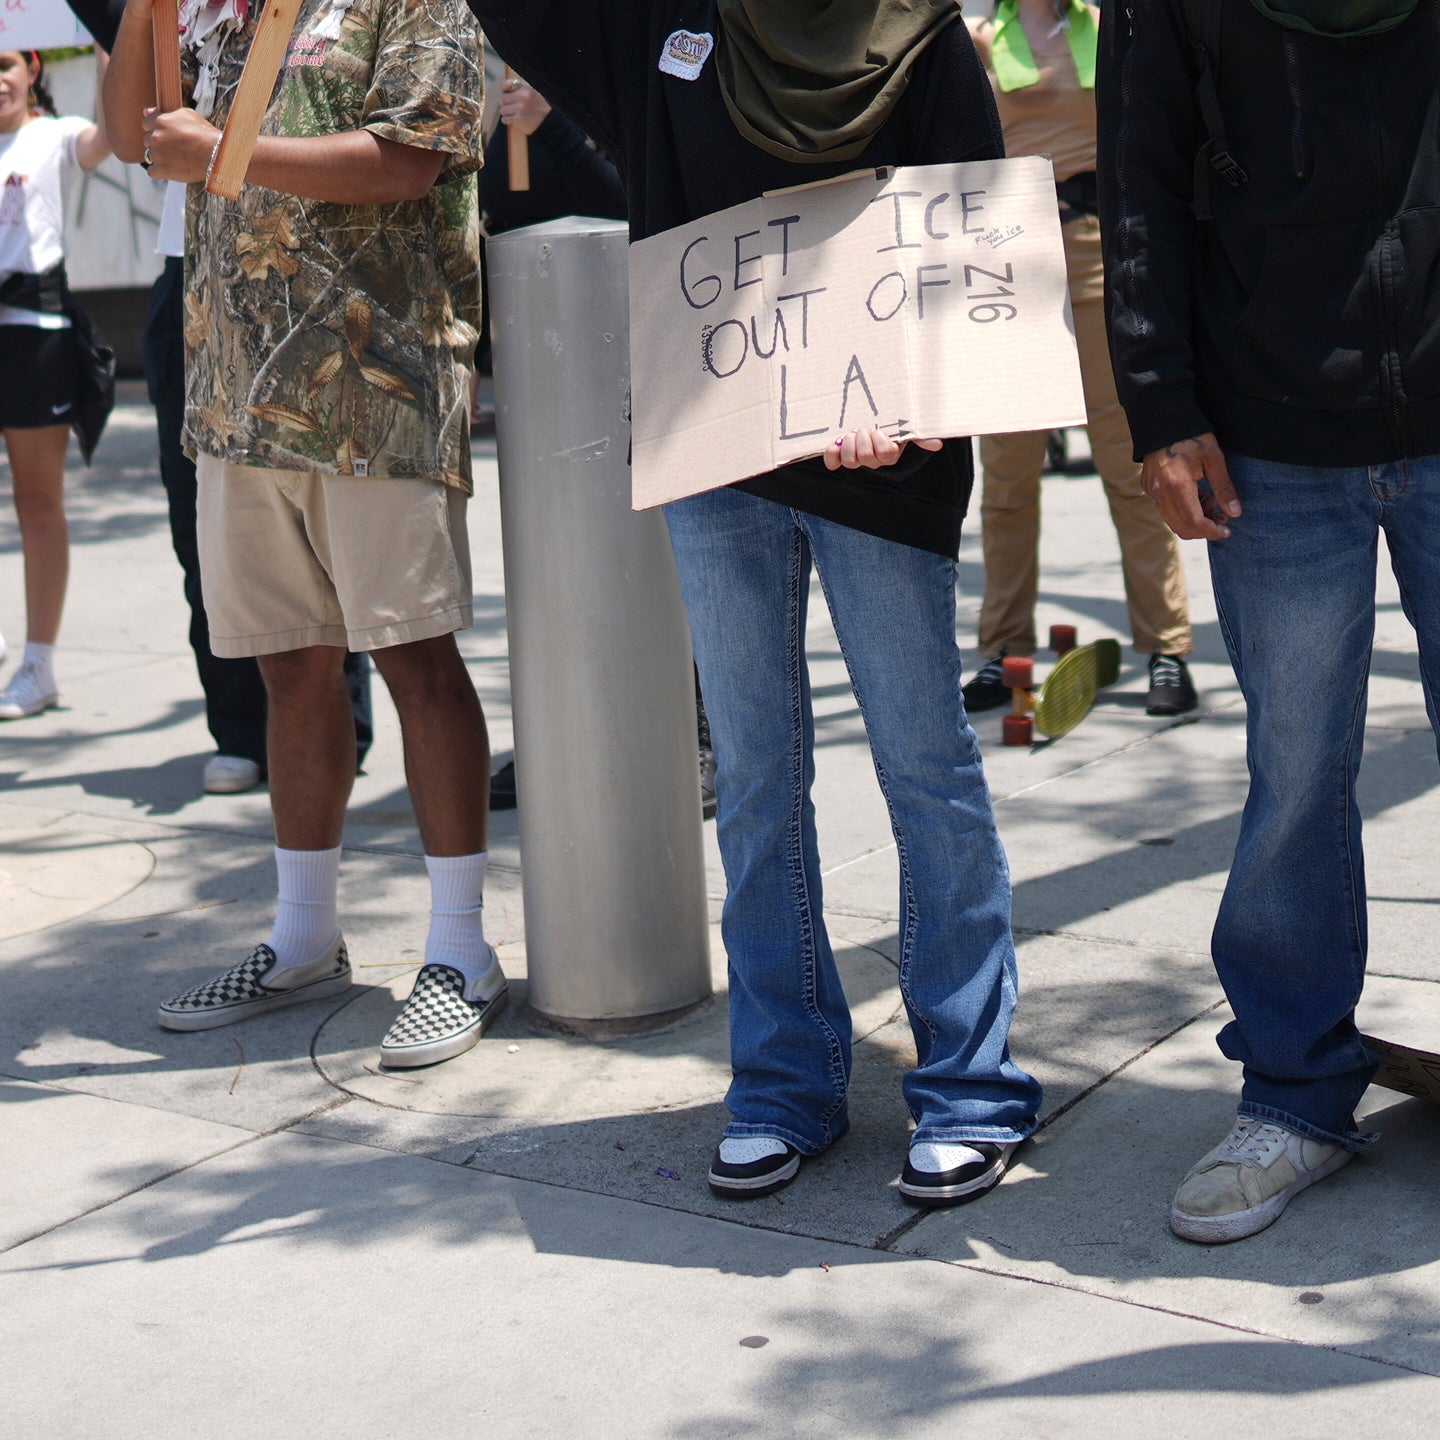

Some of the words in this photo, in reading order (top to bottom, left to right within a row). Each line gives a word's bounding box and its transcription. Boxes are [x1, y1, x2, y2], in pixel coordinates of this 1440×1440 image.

[679, 215, 801, 309] GET
[870, 190, 986, 253] ICE
[964, 262, 1017, 323] Z16
[706, 287, 827, 378] OUT
[866, 264, 951, 321] OF
[779, 354, 879, 441] LA
